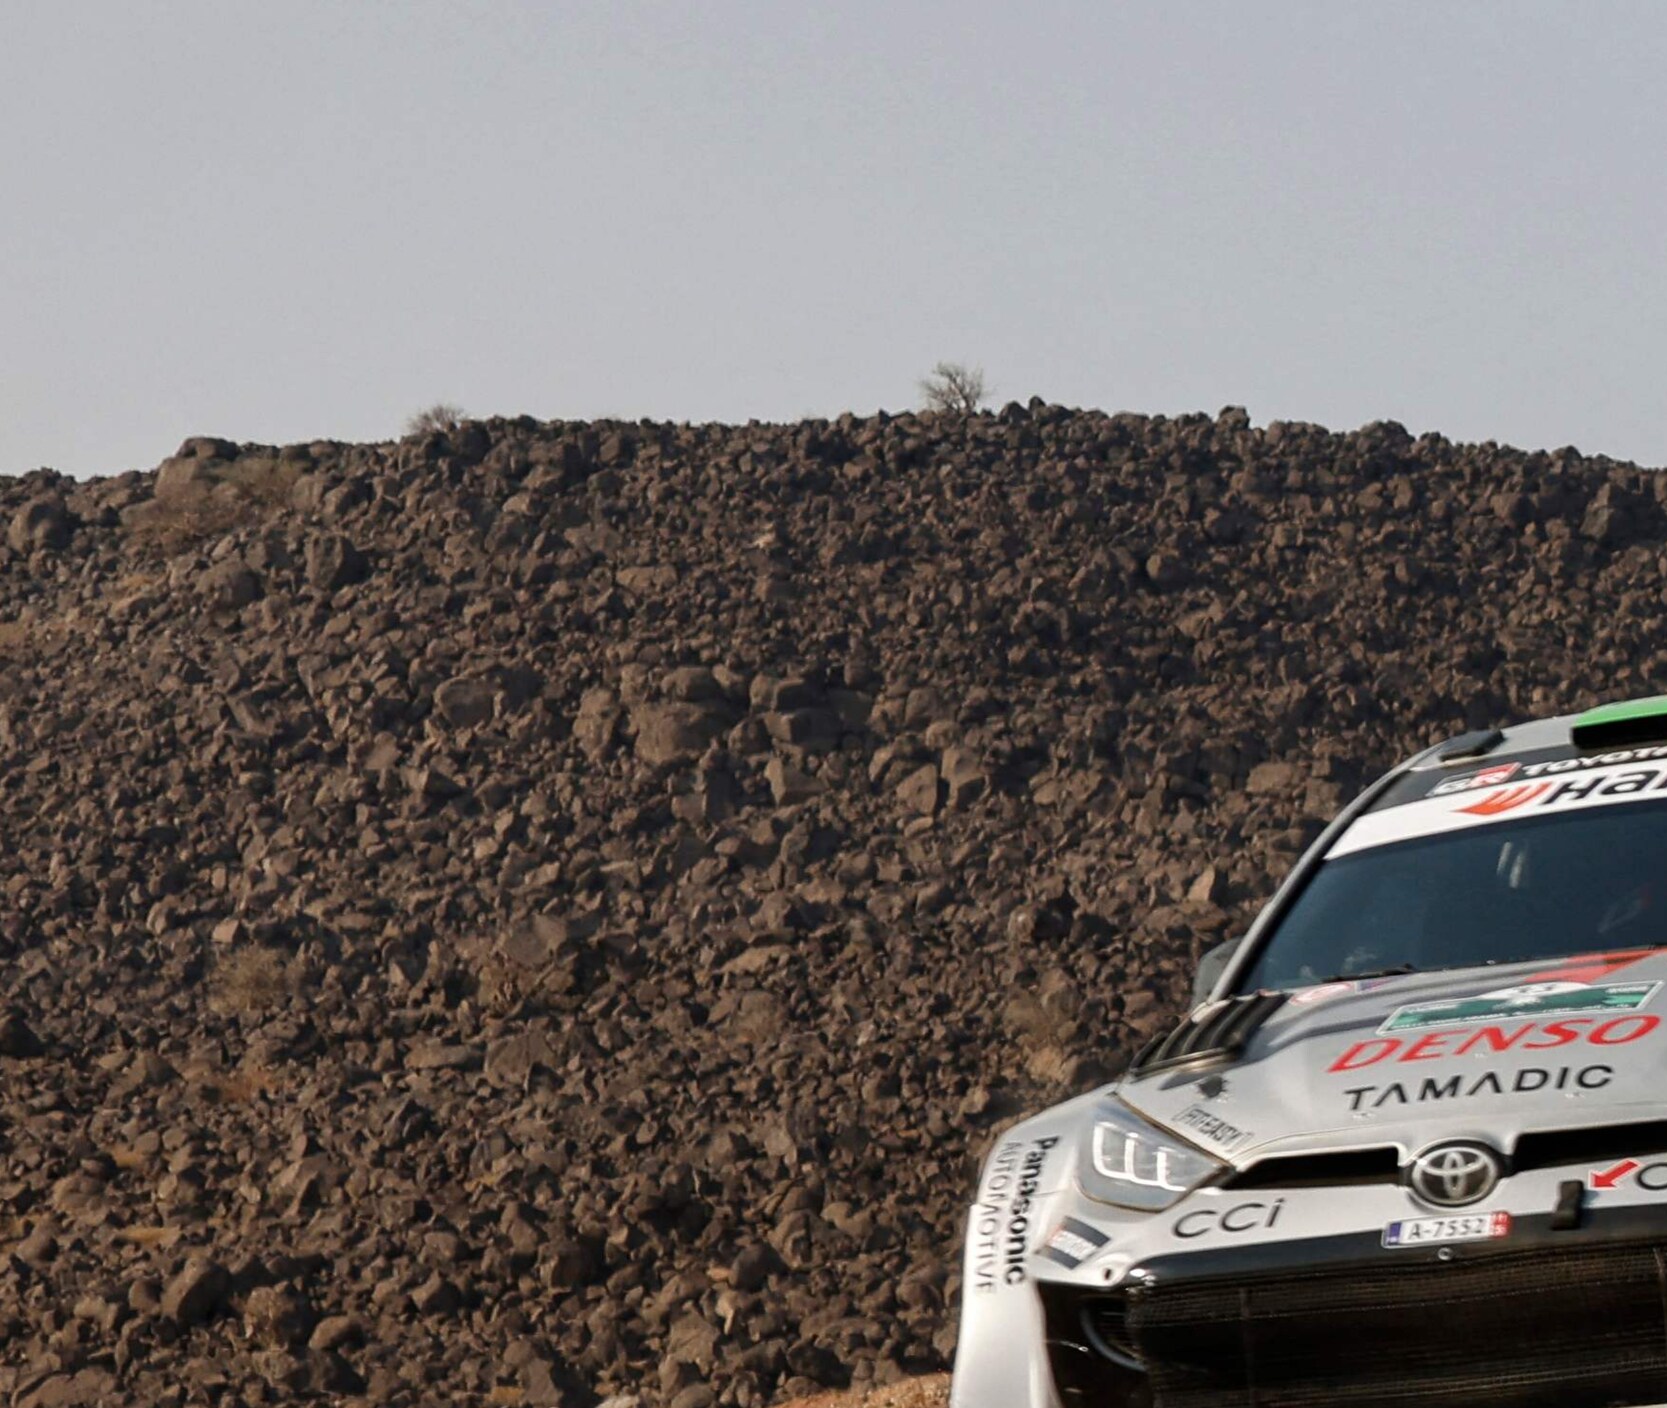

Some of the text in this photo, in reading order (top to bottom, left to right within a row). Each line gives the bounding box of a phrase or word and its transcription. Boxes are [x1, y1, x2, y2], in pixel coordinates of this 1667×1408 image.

[1327, 1015, 1661, 1072] DENSO
[1343, 1065, 1614, 1110] TAMADIC
[1005, 1135, 1061, 1286] Panasonic
[1408, 1218, 1487, 1240] A-7552
